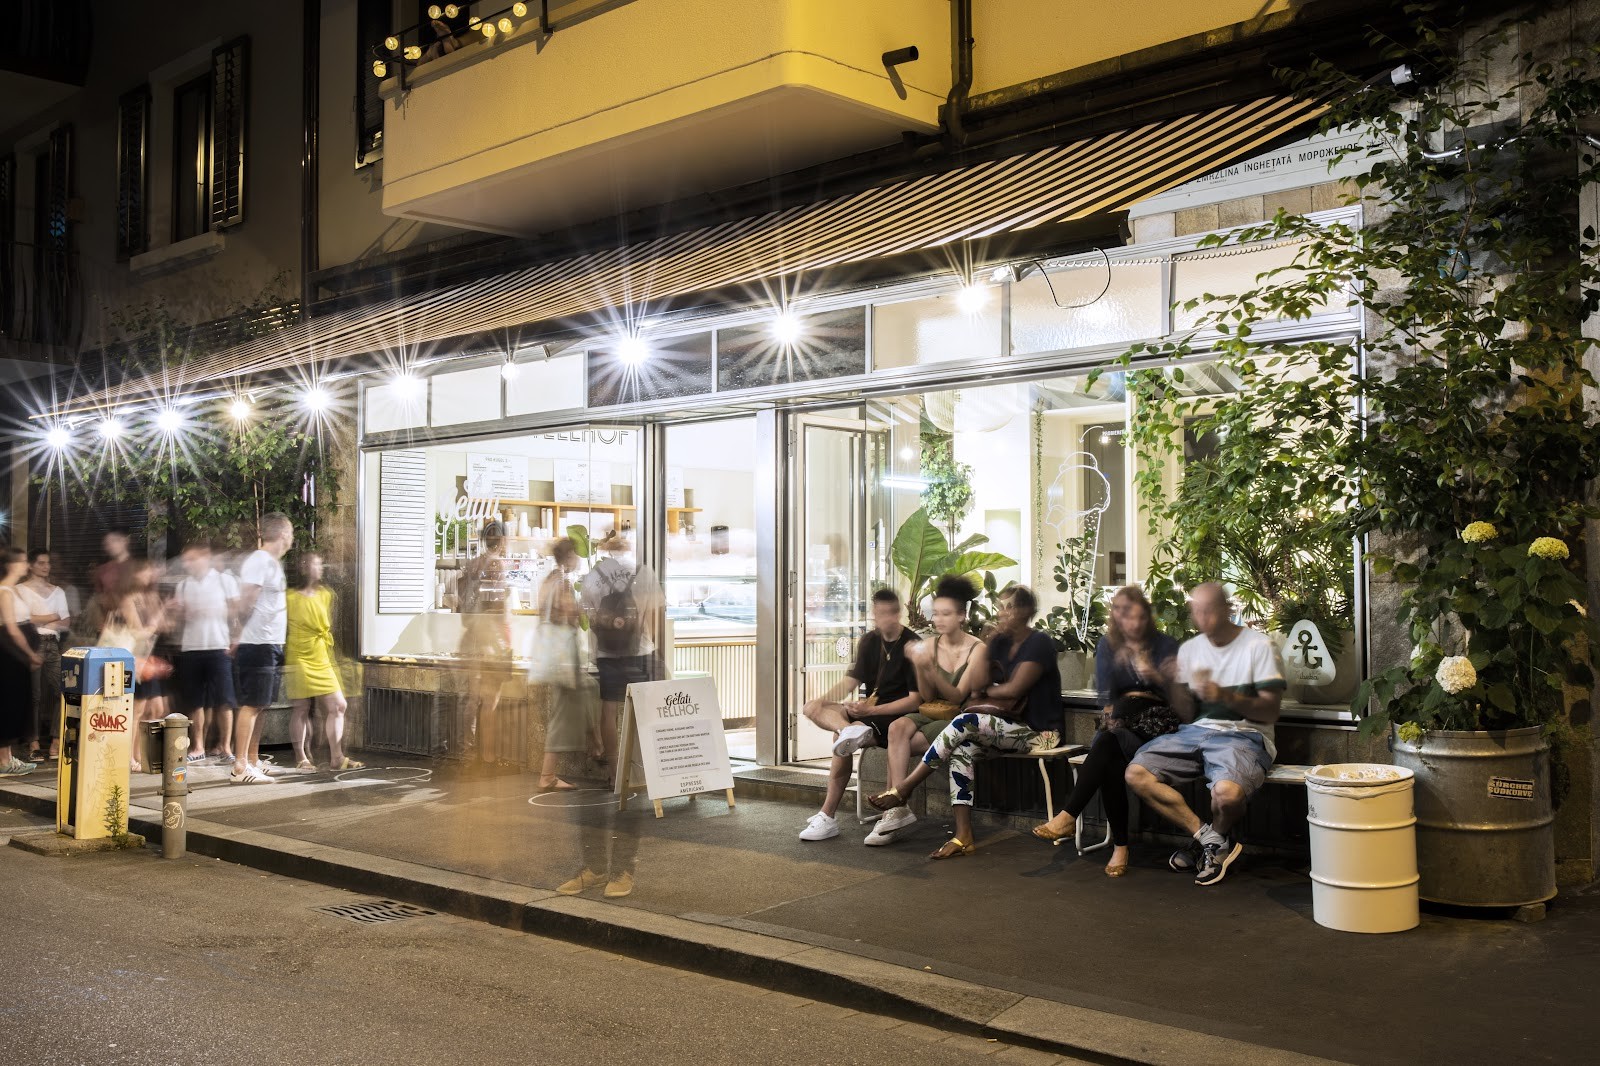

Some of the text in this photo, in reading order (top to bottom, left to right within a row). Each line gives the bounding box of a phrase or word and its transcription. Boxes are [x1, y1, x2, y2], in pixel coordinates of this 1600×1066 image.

[1298, 143, 1359, 162] МОРОЖЕОЕ
[664, 691, 691, 710] Gelati
[656, 703, 700, 718] TELLHOF
